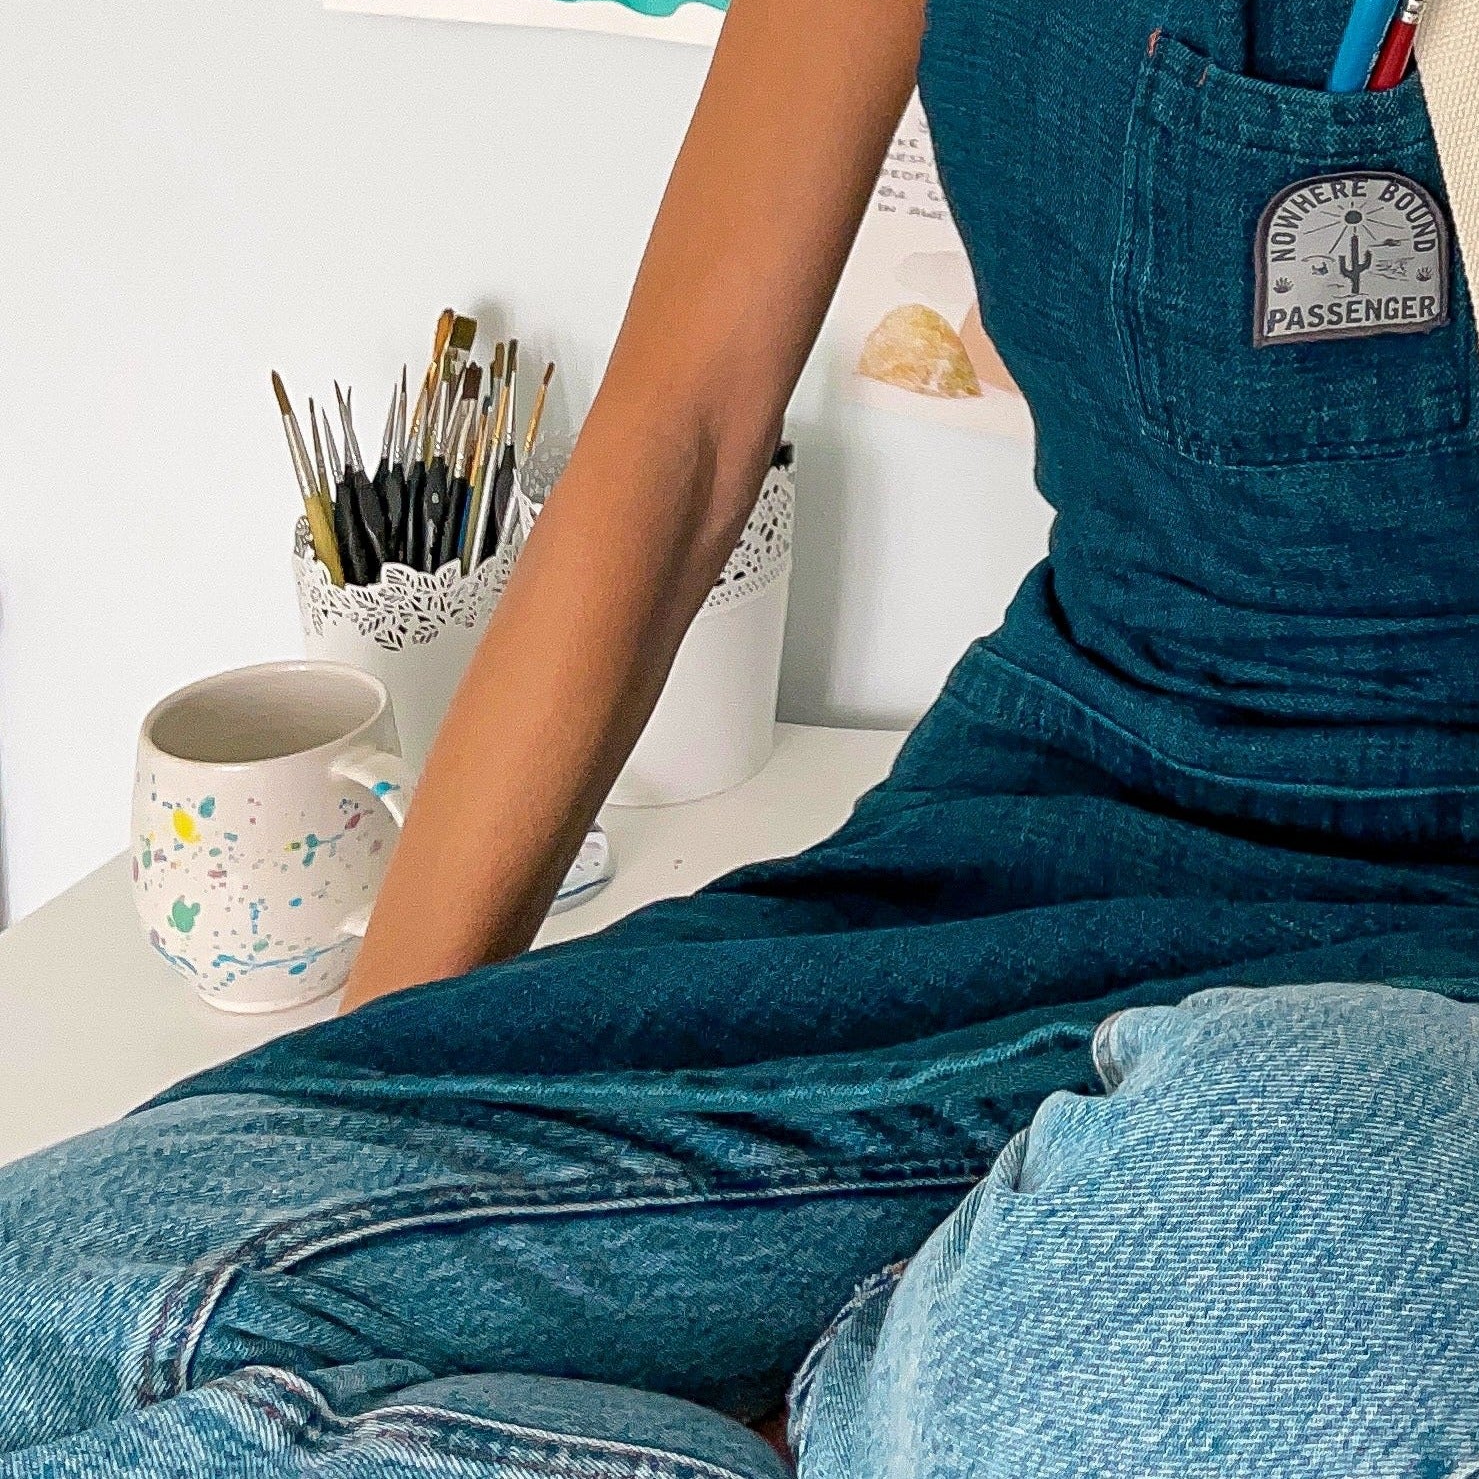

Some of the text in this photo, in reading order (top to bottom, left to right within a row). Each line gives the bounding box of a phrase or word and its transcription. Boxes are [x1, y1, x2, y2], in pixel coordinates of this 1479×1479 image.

[1270, 178, 1437, 263] NOWHERE BOUND
[1267, 295, 1436, 335] PASSENGER
